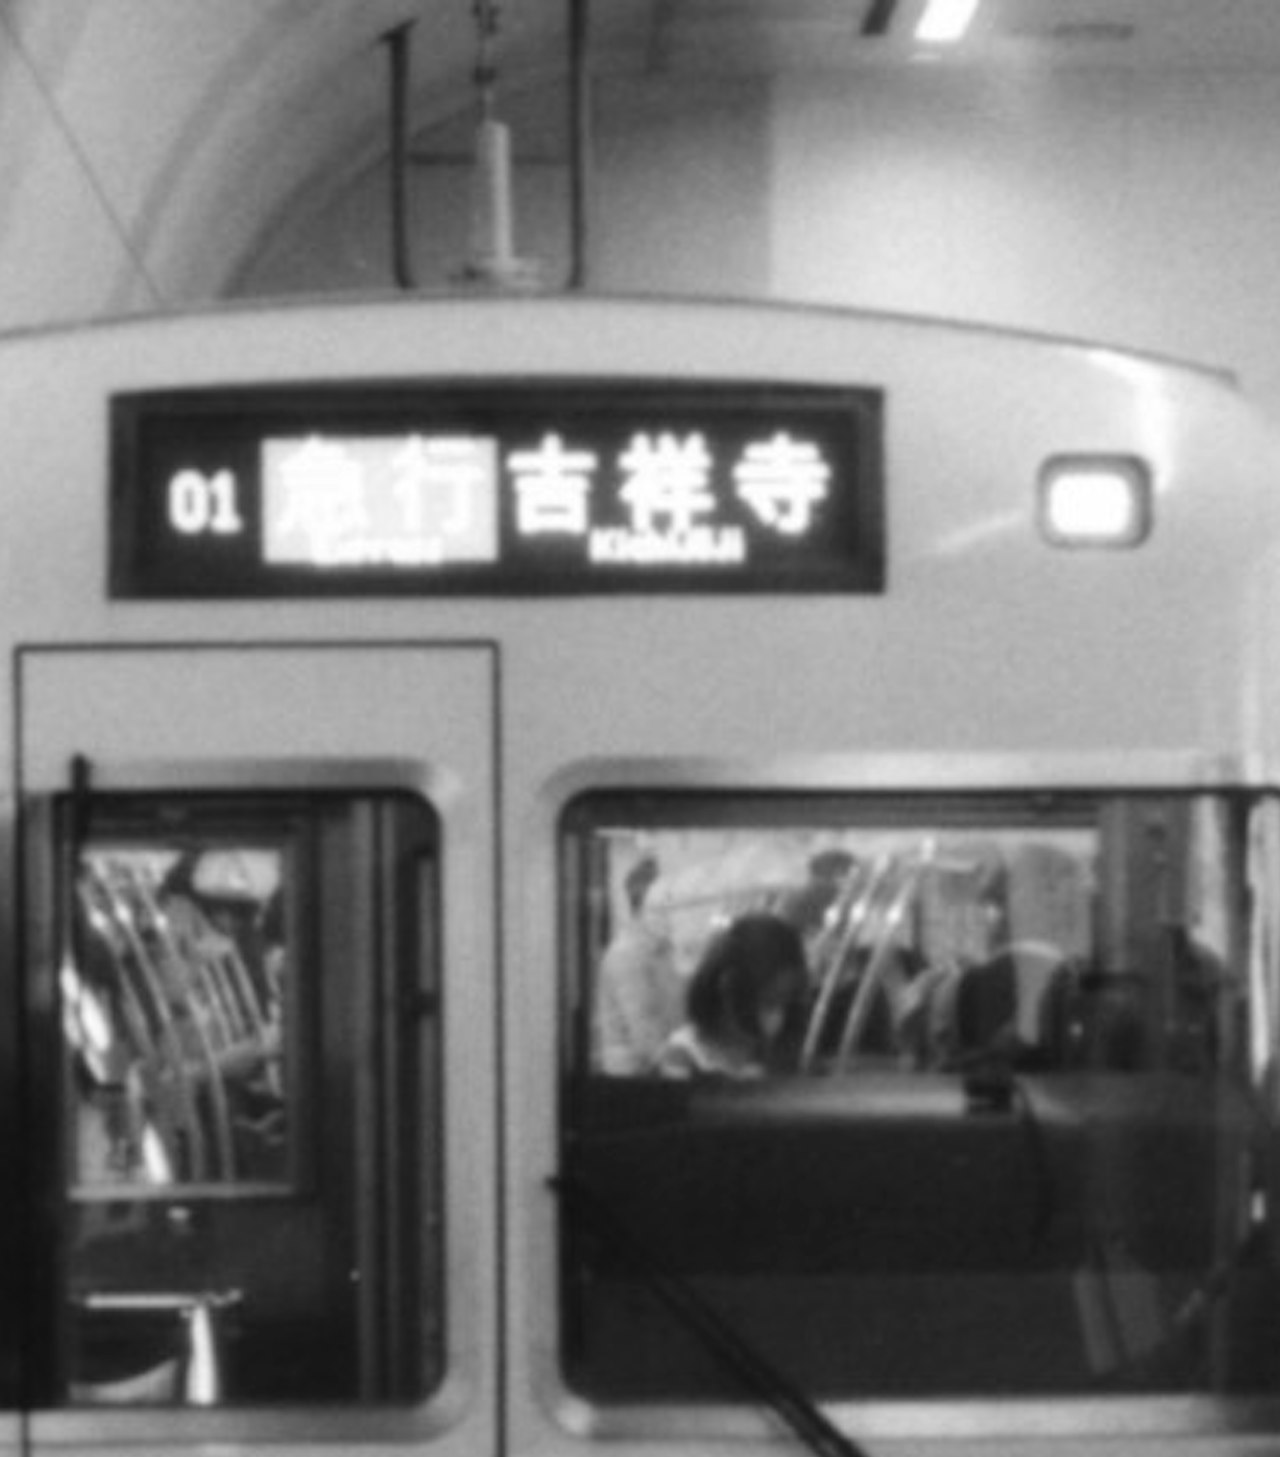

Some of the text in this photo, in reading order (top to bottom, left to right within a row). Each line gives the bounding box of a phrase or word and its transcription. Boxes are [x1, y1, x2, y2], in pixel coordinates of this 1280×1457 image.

[170, 472, 239, 533] 01
[507, 435, 829, 534] 吉祥寺
